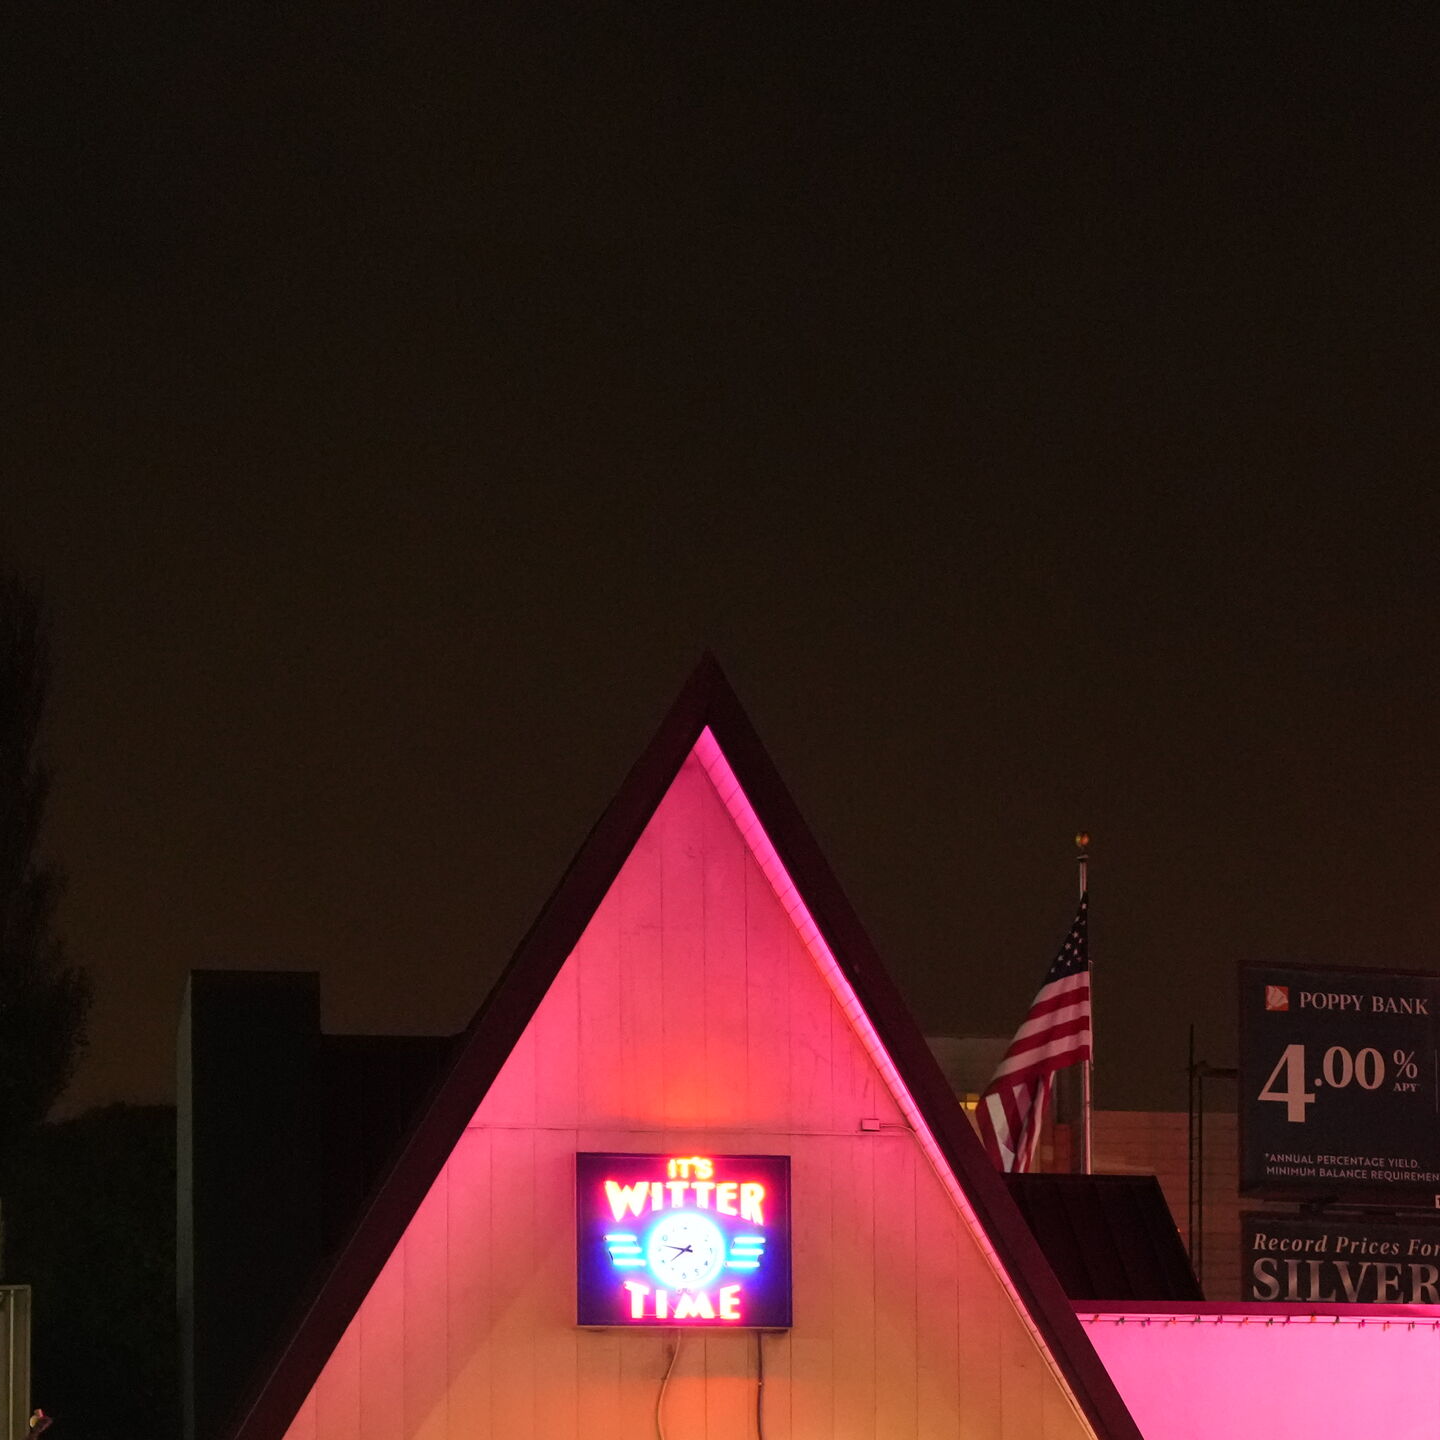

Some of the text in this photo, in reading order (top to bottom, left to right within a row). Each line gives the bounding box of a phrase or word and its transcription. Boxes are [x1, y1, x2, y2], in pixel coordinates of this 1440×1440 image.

[1299, 992, 1429, 1016] POPPY BANK
[668, 1157, 714, 1179] IT'S
[1317, 1155, 1385, 1168] PERCENTAGE
[1266, 1166, 1316, 1177] MINIMUM
[1319, 1168, 1367, 1180] BALANCE
[604, 1180, 766, 1226] WITTER
[1253, 1233, 1328, 1253] Record
[1336, 1236, 1400, 1255] Prices
[624, 1281, 740, 1319] TIME
